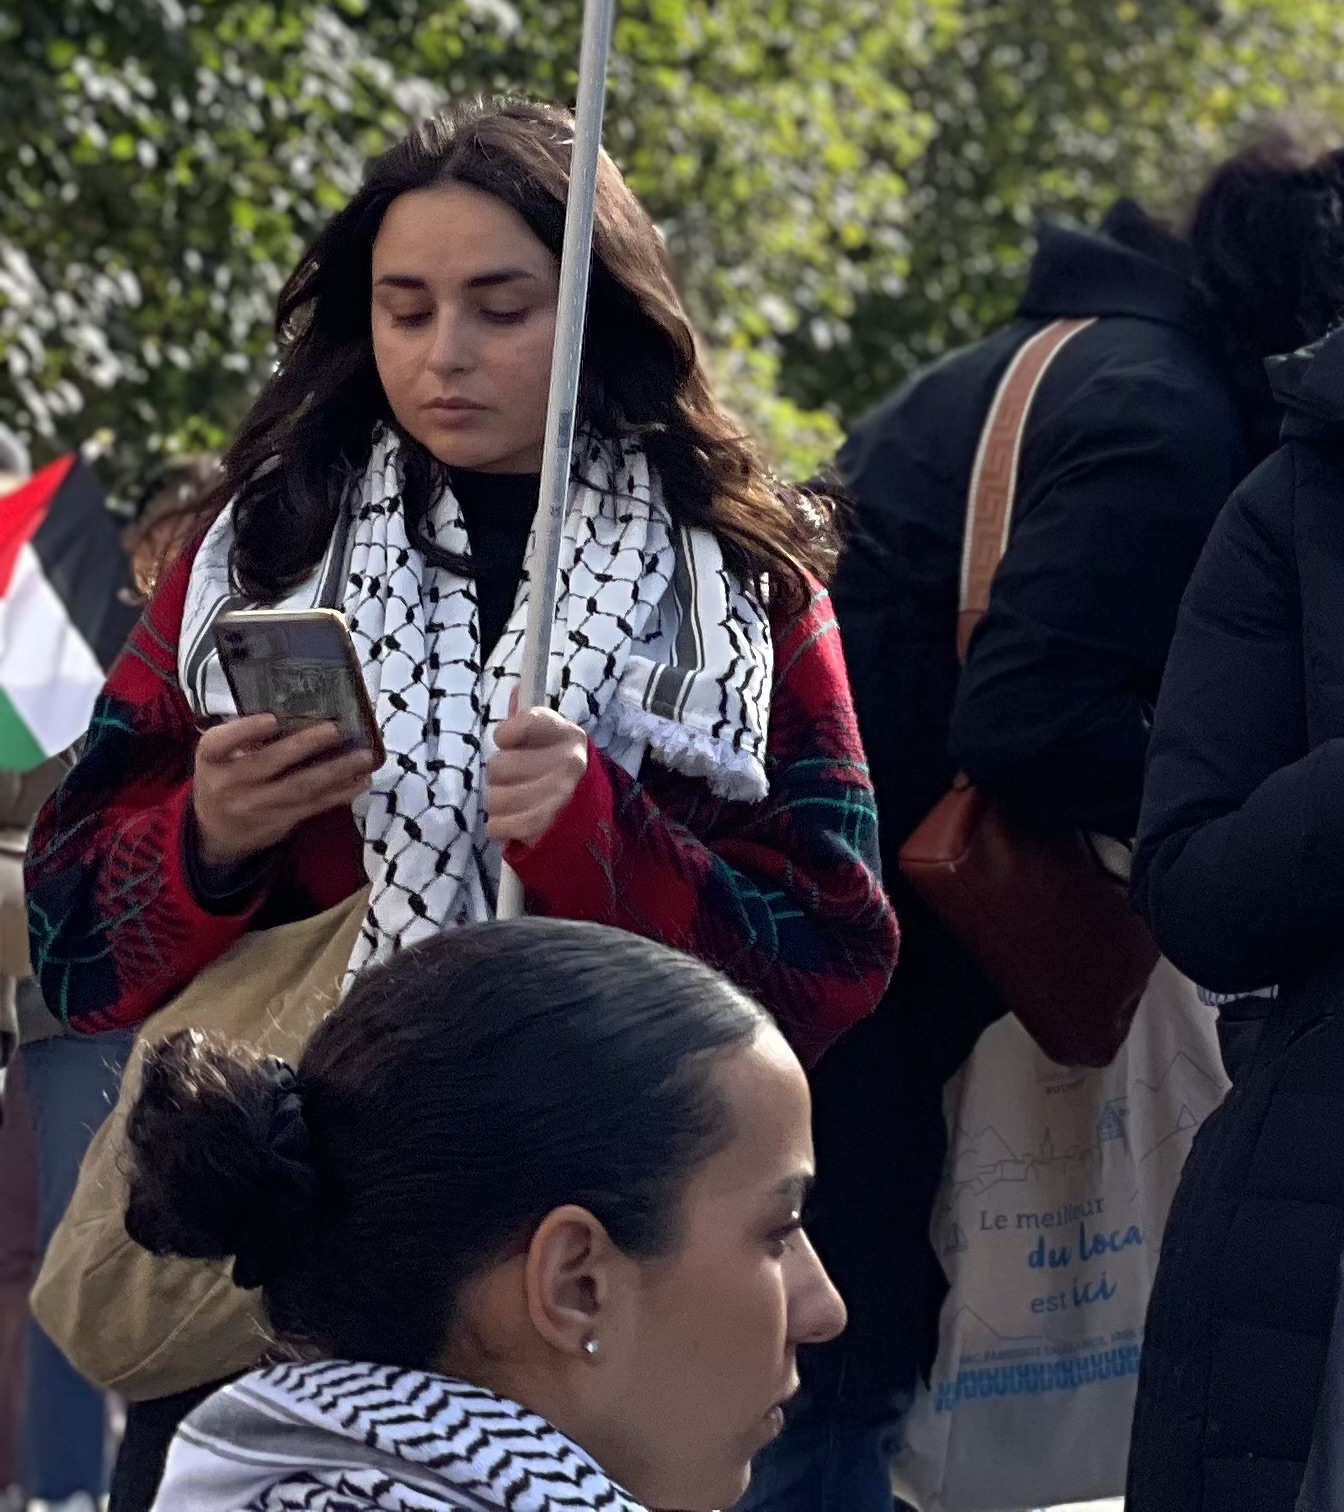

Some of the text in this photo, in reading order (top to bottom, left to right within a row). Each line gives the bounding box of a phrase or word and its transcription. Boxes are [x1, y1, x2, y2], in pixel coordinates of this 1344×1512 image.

[979, 1199, 1104, 1231] Le meilleur
[1028, 1234, 1073, 1269] du
[1030, 1270, 1118, 1314] est ici
